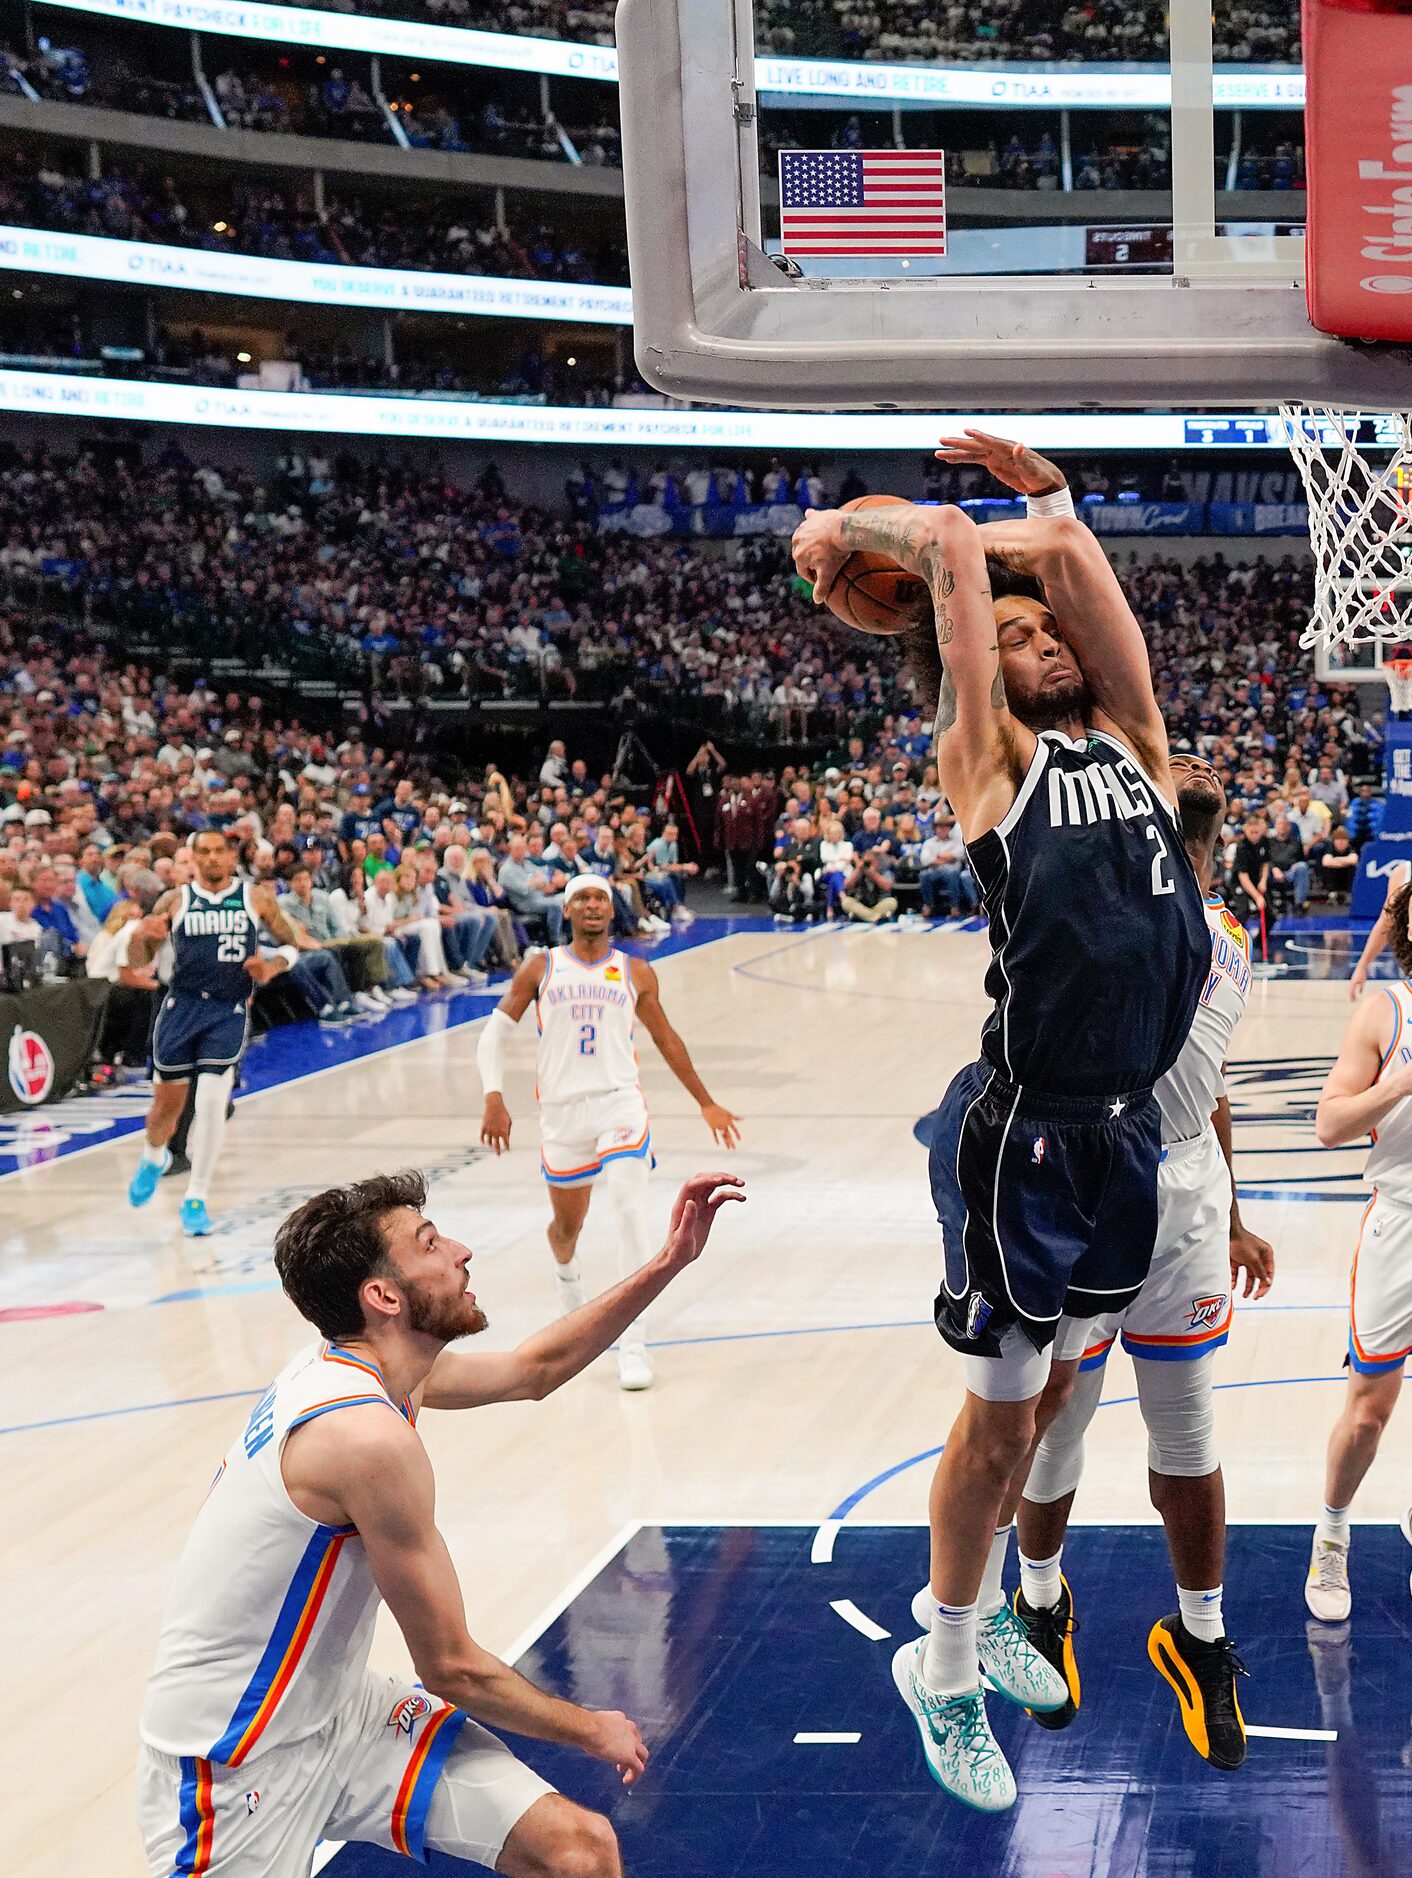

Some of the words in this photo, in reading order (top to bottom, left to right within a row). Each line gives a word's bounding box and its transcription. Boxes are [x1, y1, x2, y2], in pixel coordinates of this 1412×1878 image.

[766, 65, 802, 86] LIVE
[807, 69, 849, 88] LONG
[855, 72, 887, 91] AND
[1012, 81, 1050, 98] TIAA
[149, 255, 189, 275] TIAA
[579, 296, 633, 313] PAYCHEC
[1146, 823, 1176, 896] 2
[184, 909, 249, 937] MAVS
[217, 933, 248, 963] 25
[547, 983, 628, 1009] OKLAHOMA
[572, 1003, 605, 1021] CITY
[579, 1023, 598, 1057] 2
[399, 1696, 422, 1735] OKC
